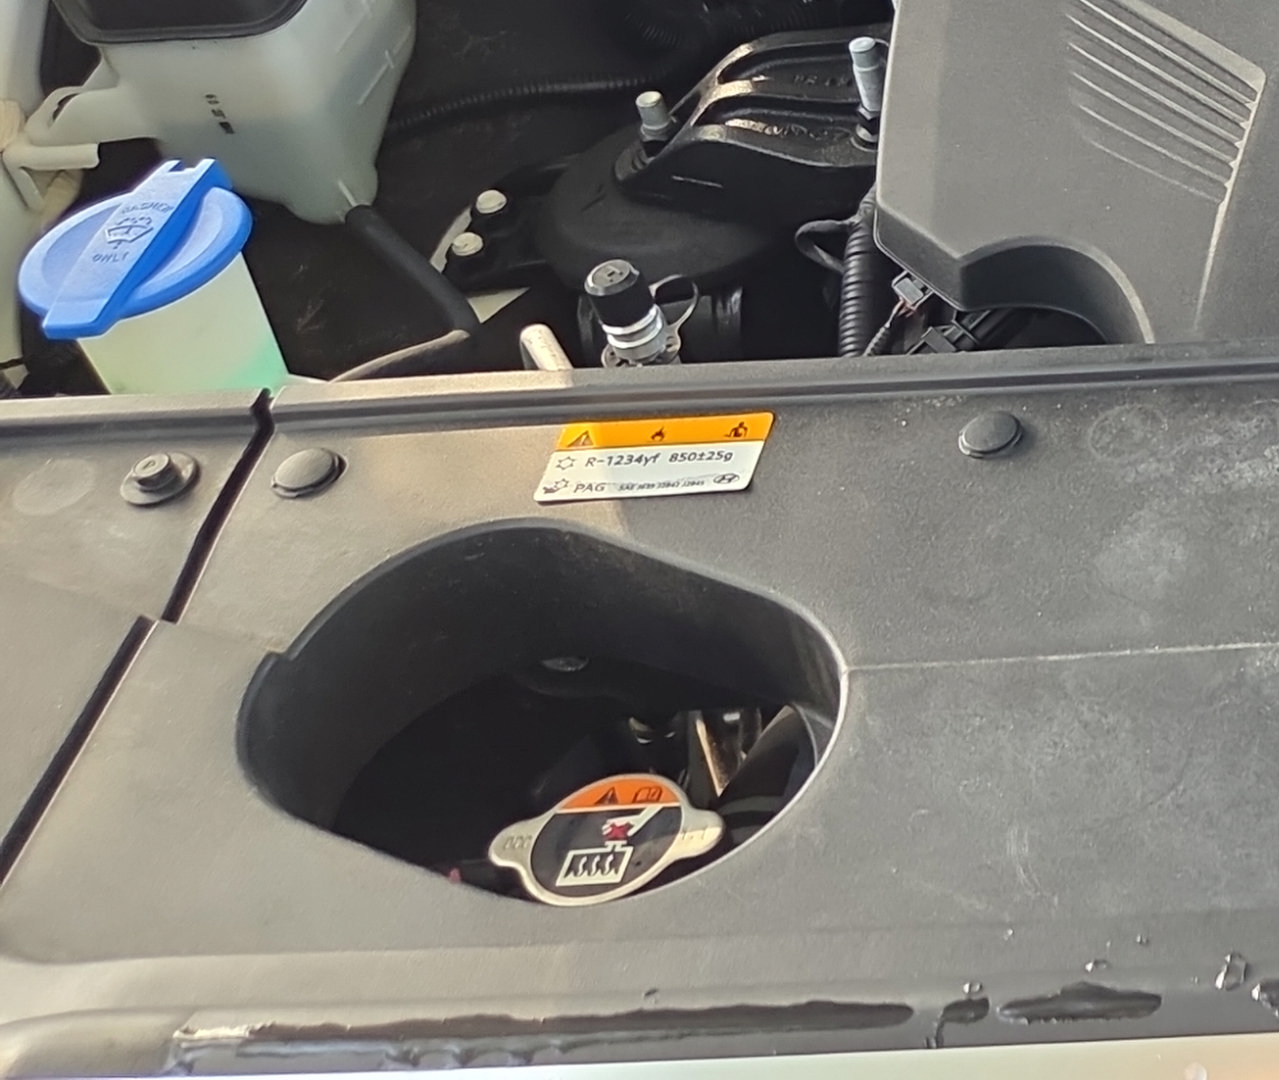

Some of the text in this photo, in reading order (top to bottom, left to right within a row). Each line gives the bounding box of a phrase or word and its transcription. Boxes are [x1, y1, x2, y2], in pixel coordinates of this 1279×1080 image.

[92, 250, 130, 263] ONLY
[584, 450, 734, 468] R-1234yf 850±25g
[573, 481, 608, 494] PAG
